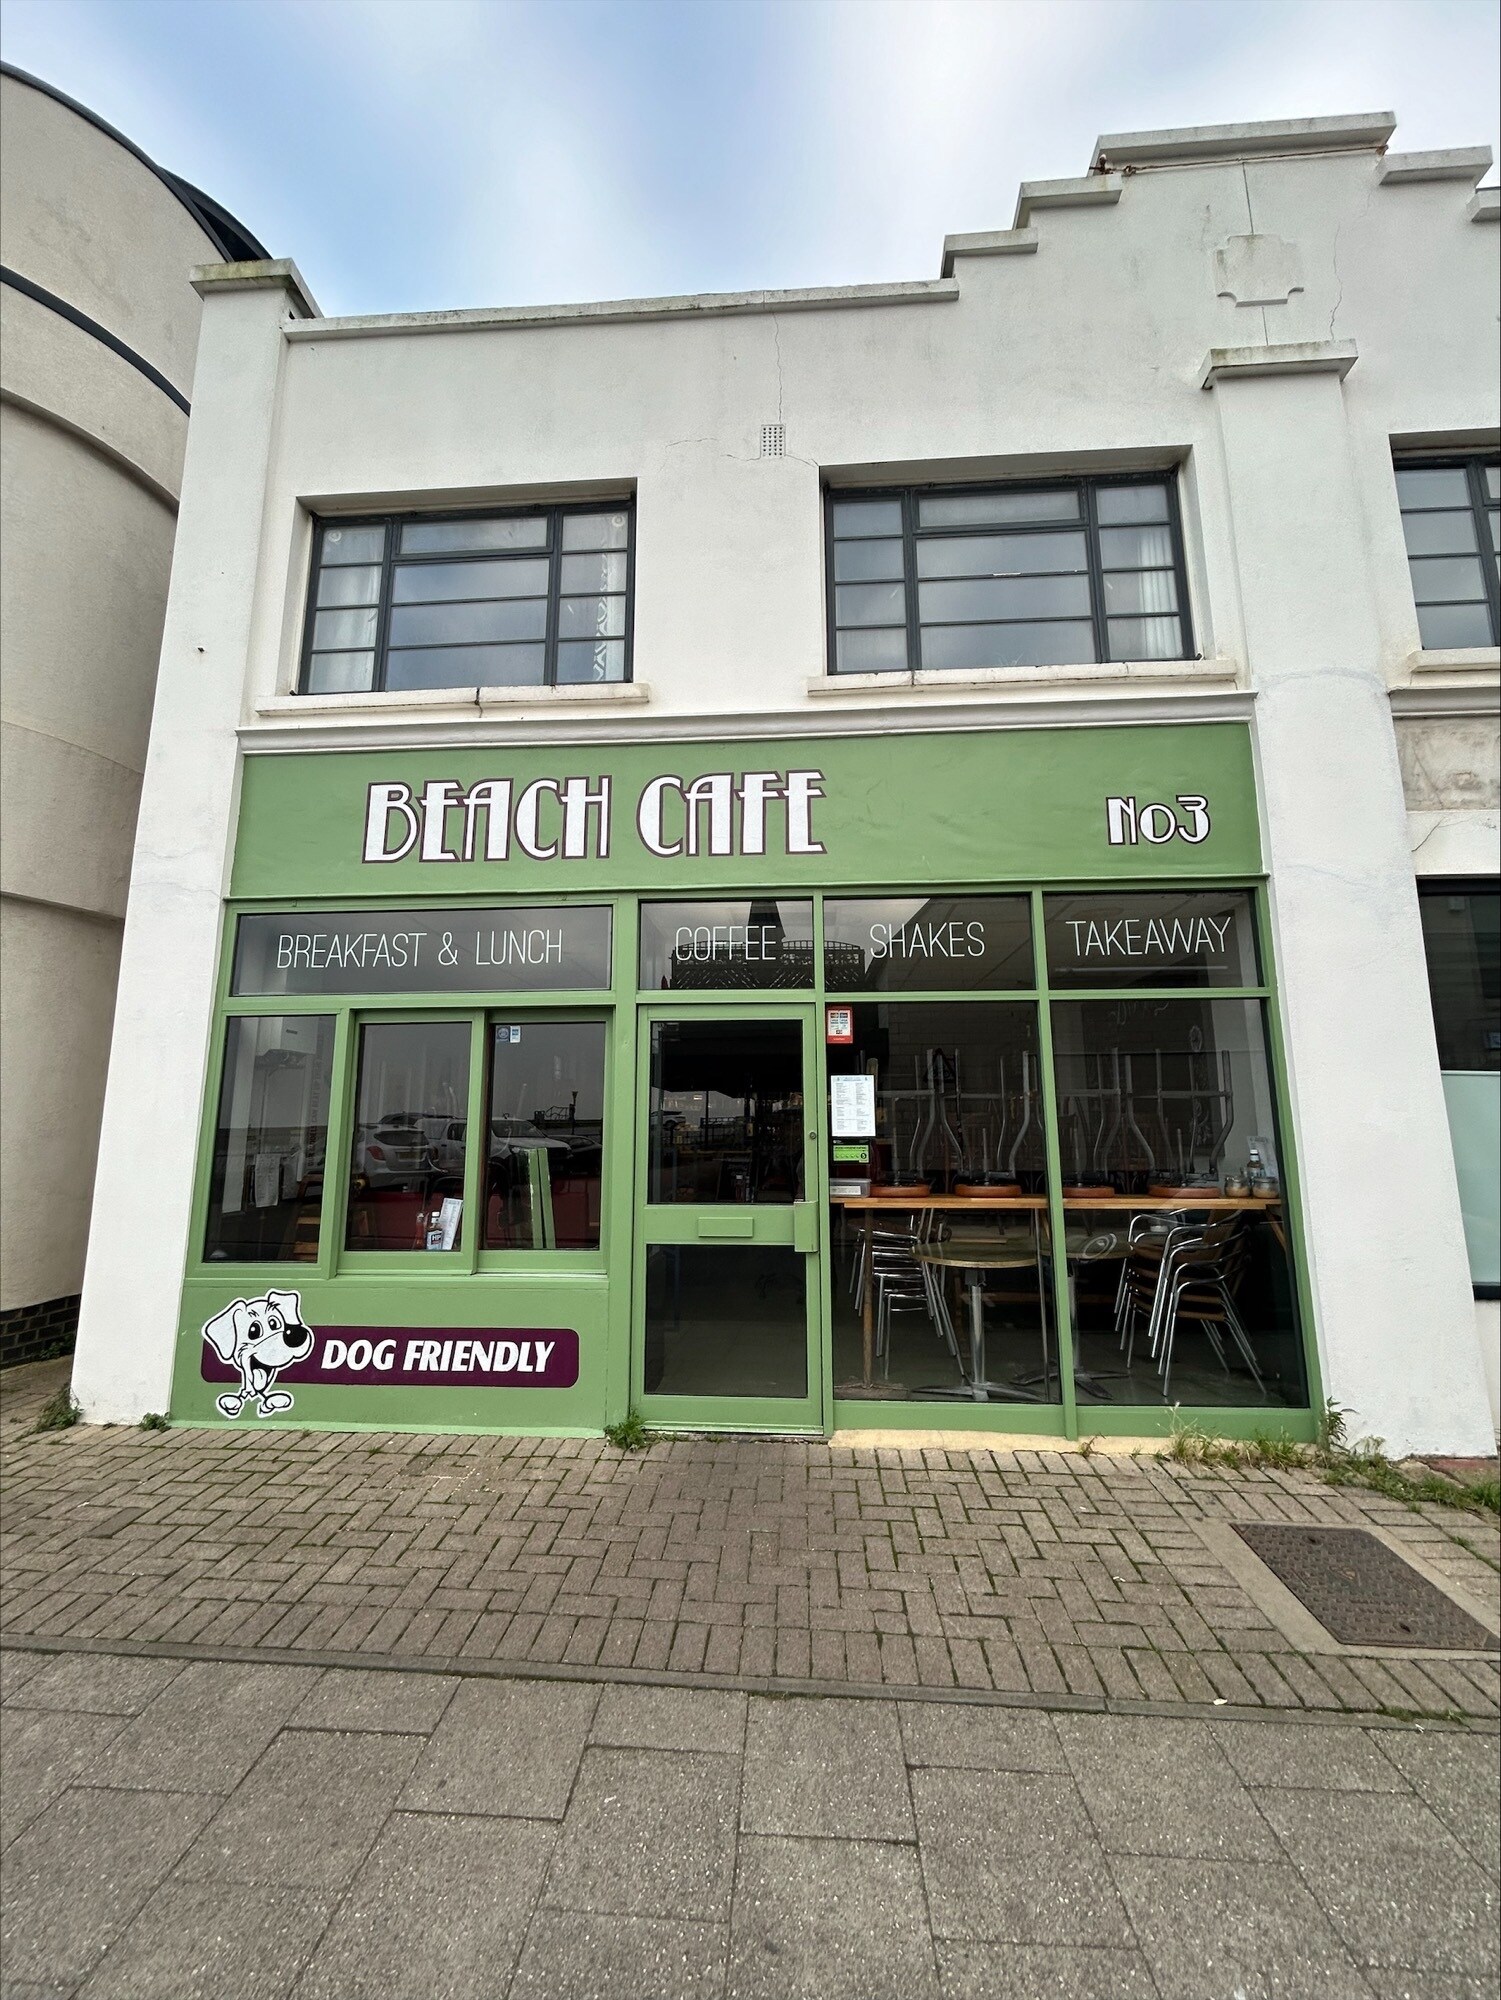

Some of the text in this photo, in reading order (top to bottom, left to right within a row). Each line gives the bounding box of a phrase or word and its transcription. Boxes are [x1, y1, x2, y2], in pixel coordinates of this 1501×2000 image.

[362, 769, 827, 864] BEACH CAFE
[1105, 795, 1211, 846] No3
[276, 929, 563, 969] BREAKFAST & LUNCH
[675, 924, 777, 961] COFFEE
[869, 921, 986, 959] SHAKES
[1066, 916, 1232, 958] TAKEAWAY
[321, 1339, 556, 1373] DOG FRIENDLY
